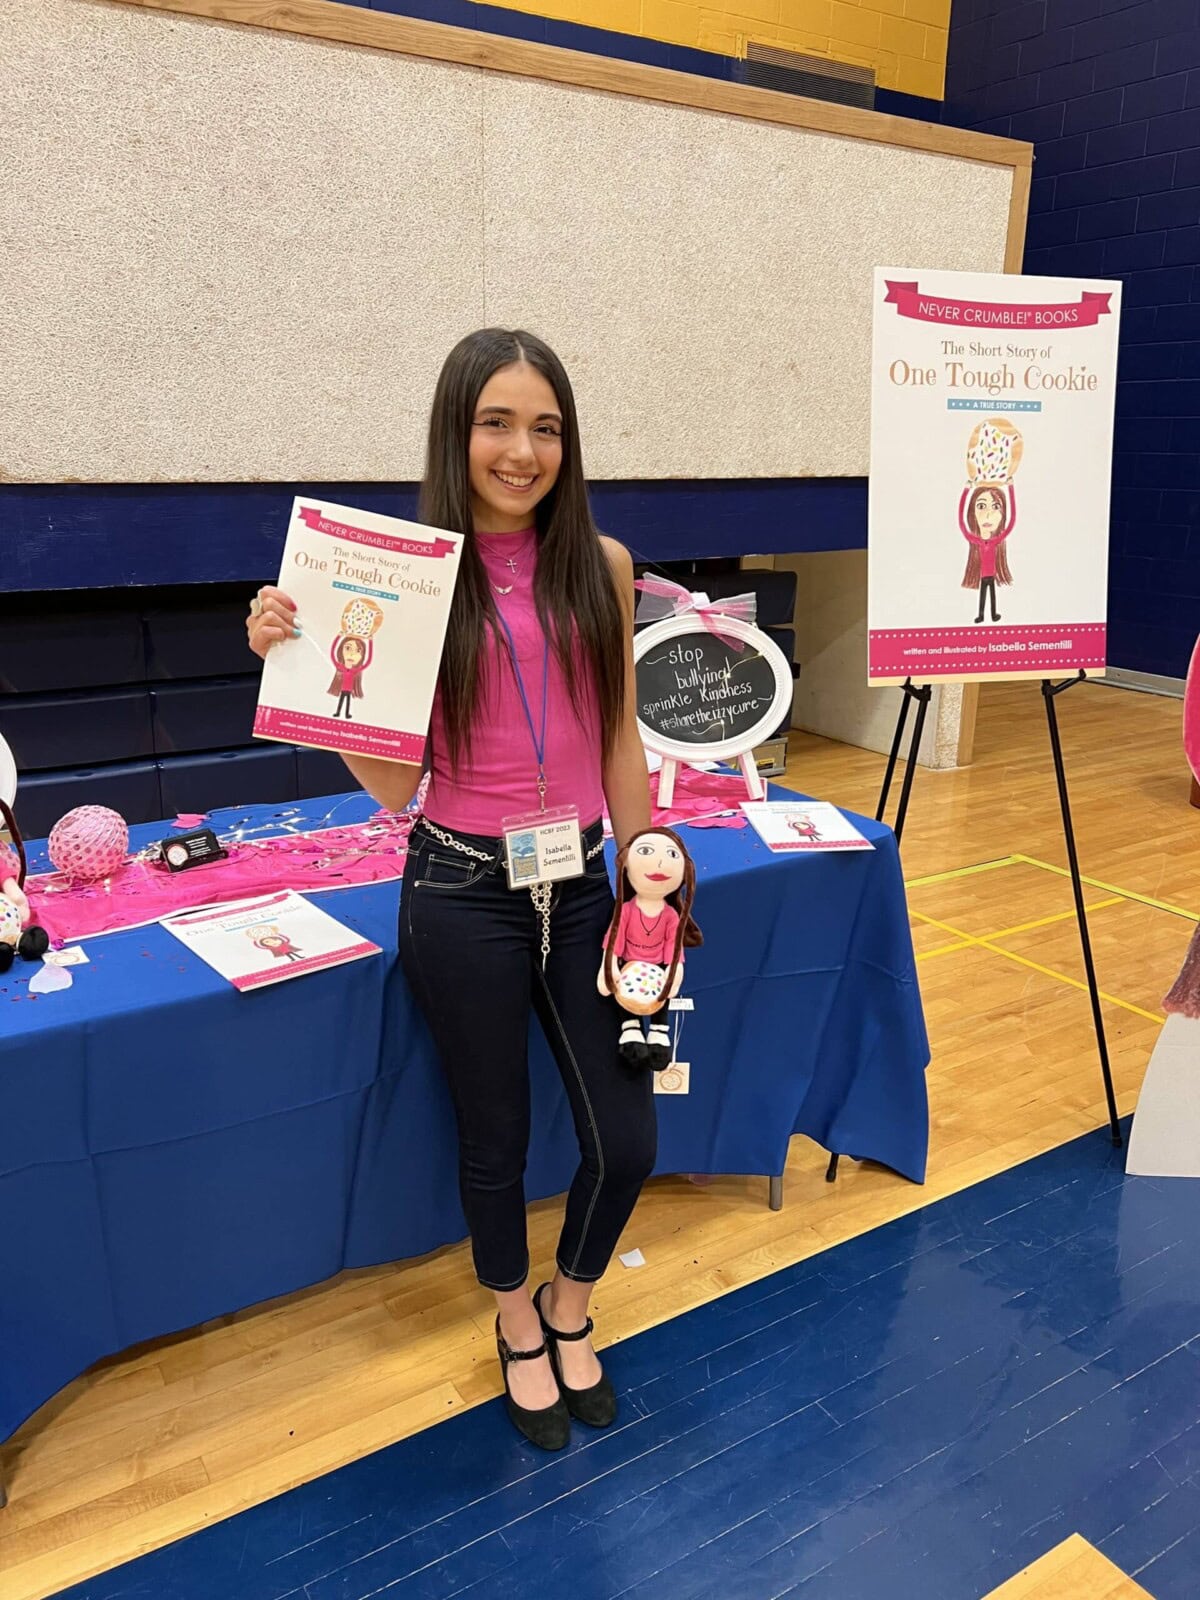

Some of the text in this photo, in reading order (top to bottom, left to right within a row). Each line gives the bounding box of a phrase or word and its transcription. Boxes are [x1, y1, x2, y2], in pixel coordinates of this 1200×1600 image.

[918, 301, 959, 320] NEVER
[1035, 308, 1079, 325] BOOKS
[941, 340, 1053, 362] The Short Story of
[889, 359, 1098, 396] One Tough Cookie
[972, 401, 1017, 411] A TRUE STORY
[318, 520, 347, 537] NEVER
[402, 542, 433, 555] BOOKS
[332, 546, 412, 572] The Short Story of
[294, 551, 441, 598] One Tough Cookie
[668, 643, 704, 670] stop
[903, 640, 1073, 656] written and illustrated by Isabella Sementilli
[340, 730, 368, 742] Isabella
[556, 824, 571, 833] 2023
[545, 844, 572, 855] Isabella
[543, 855, 576, 867] Sementilli
